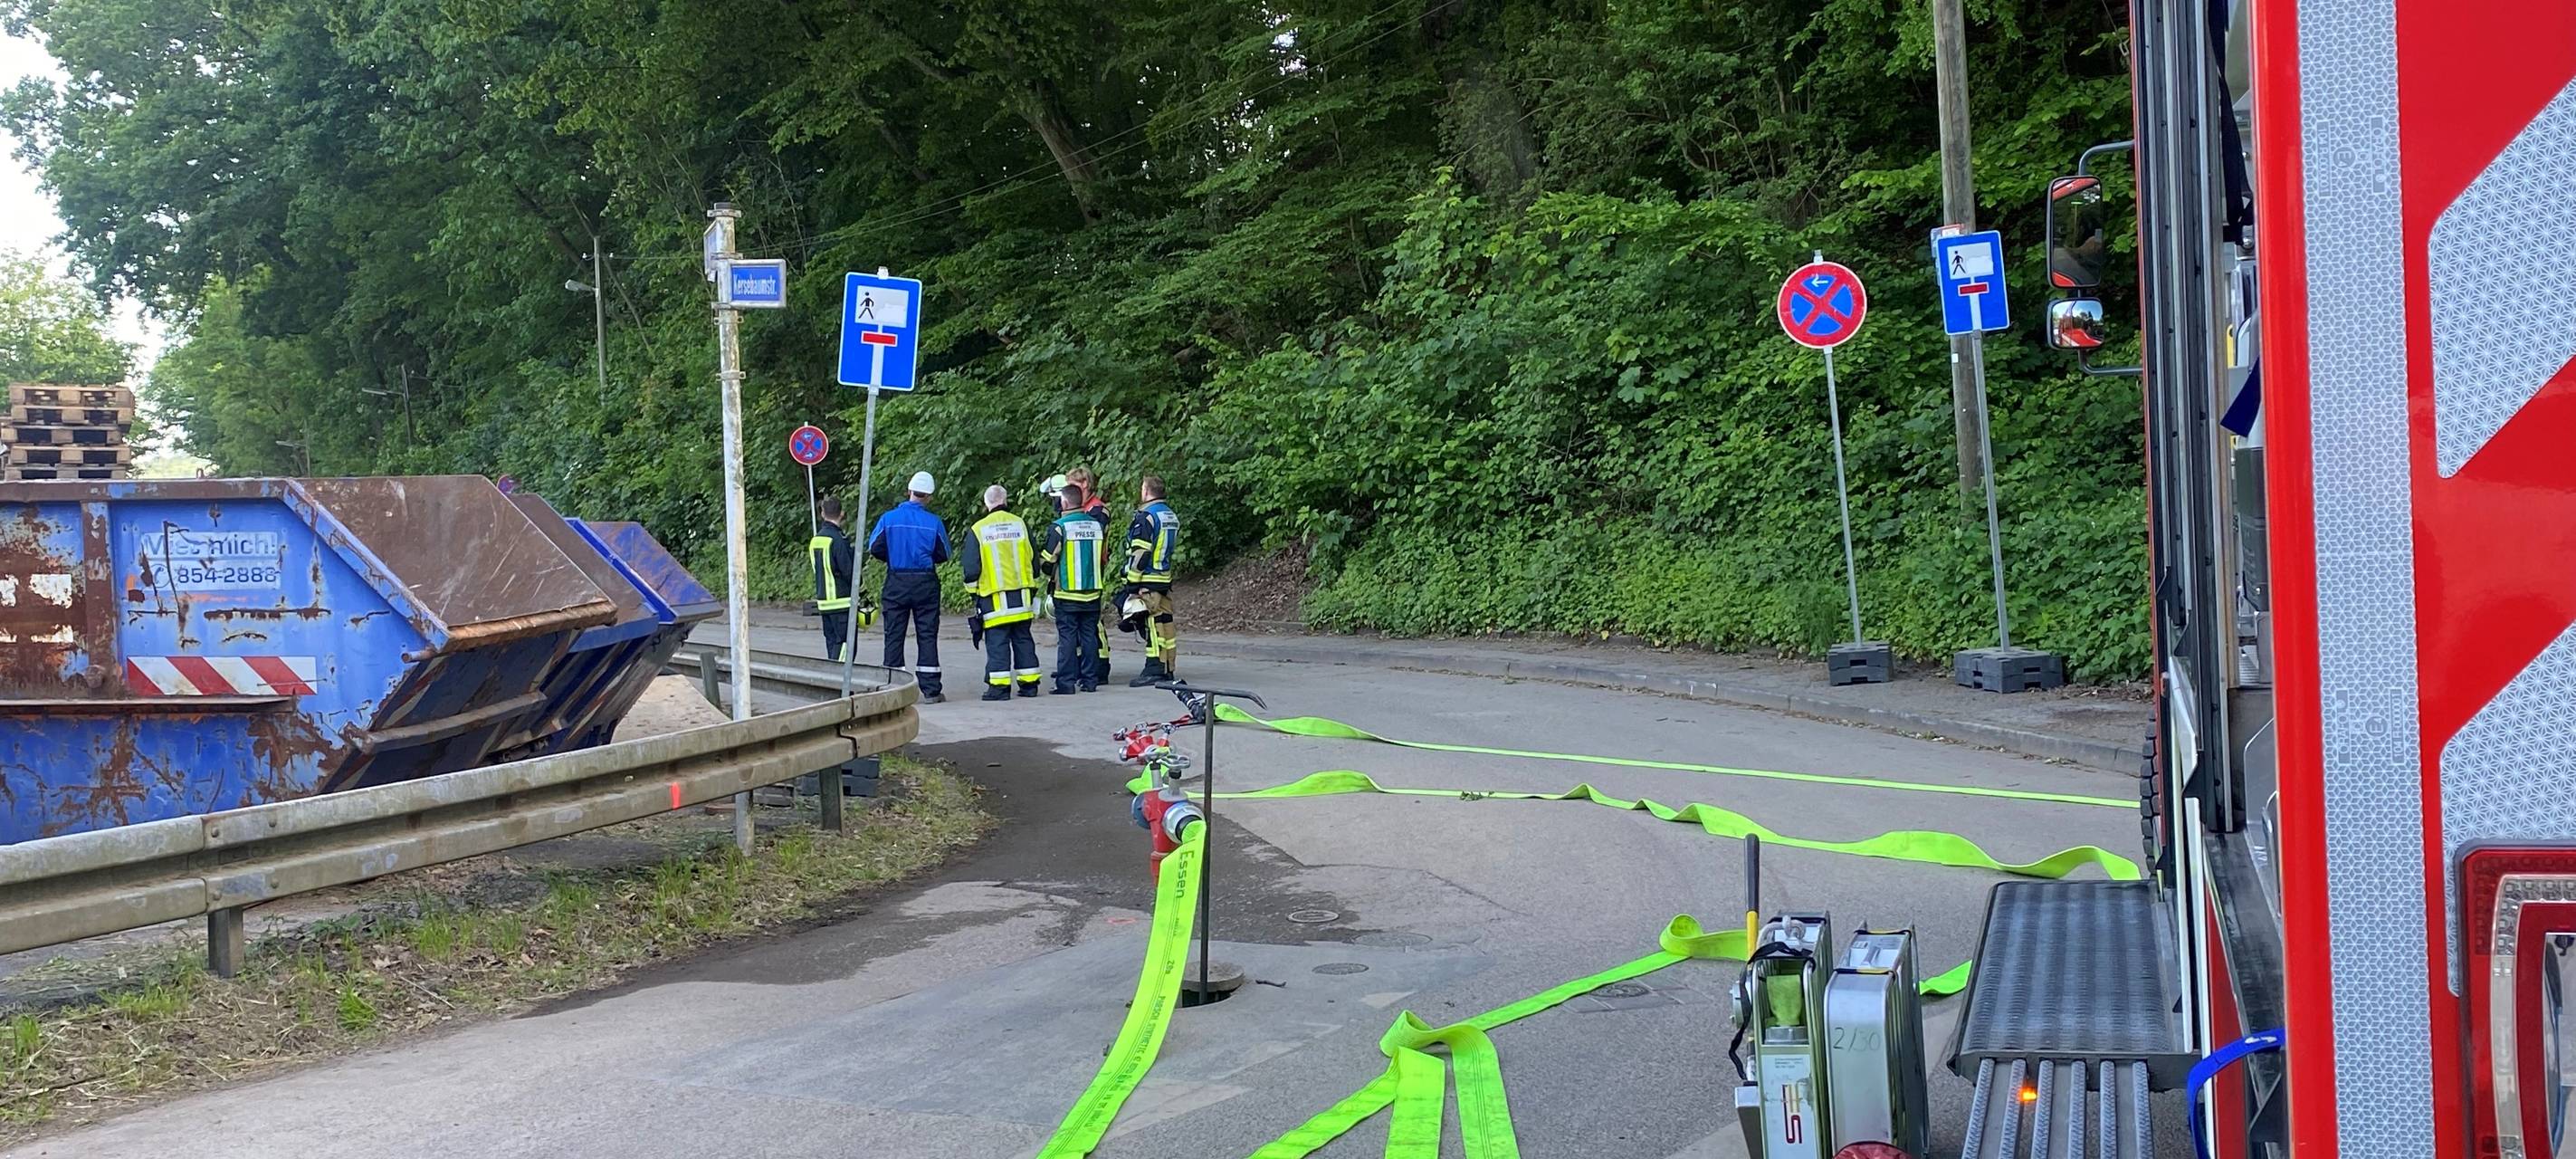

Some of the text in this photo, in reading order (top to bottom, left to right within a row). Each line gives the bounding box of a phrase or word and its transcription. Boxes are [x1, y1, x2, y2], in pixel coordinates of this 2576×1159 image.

[177, 567, 277, 584] 854-2888
[1176, 849, 1195, 899] Essen
[1832, 1026, 1881, 1053] 2/30
